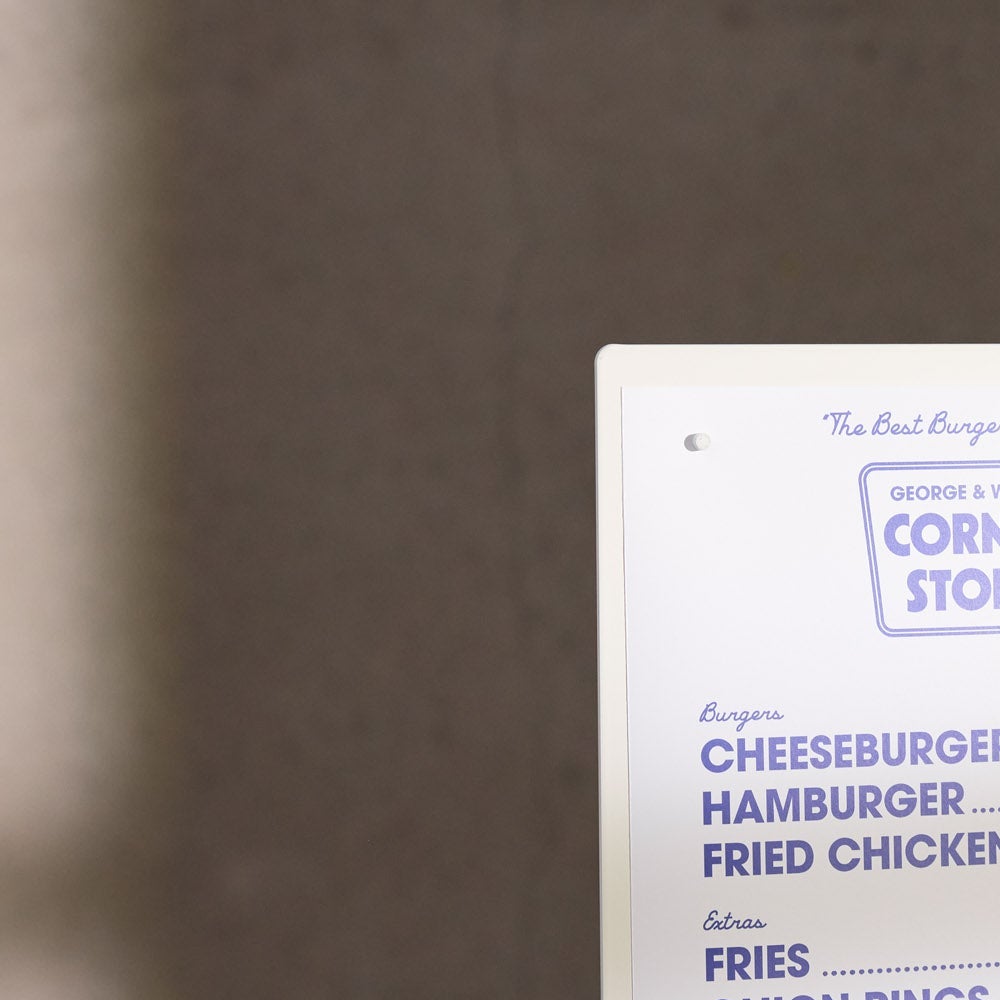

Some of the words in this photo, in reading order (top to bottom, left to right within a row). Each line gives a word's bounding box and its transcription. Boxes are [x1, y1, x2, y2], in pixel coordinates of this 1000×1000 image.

[871, 410, 924, 437] Best
[890, 485, 967, 501] GEORGE
[973, 485, 984, 499] &
[699, 701, 784, 732] Burgers
[702, 781, 964, 826] HAMBURGER
[704, 840, 814, 878] FRIED
[703, 909, 766, 931] Extras
[705, 944, 810, 982] FRIES
